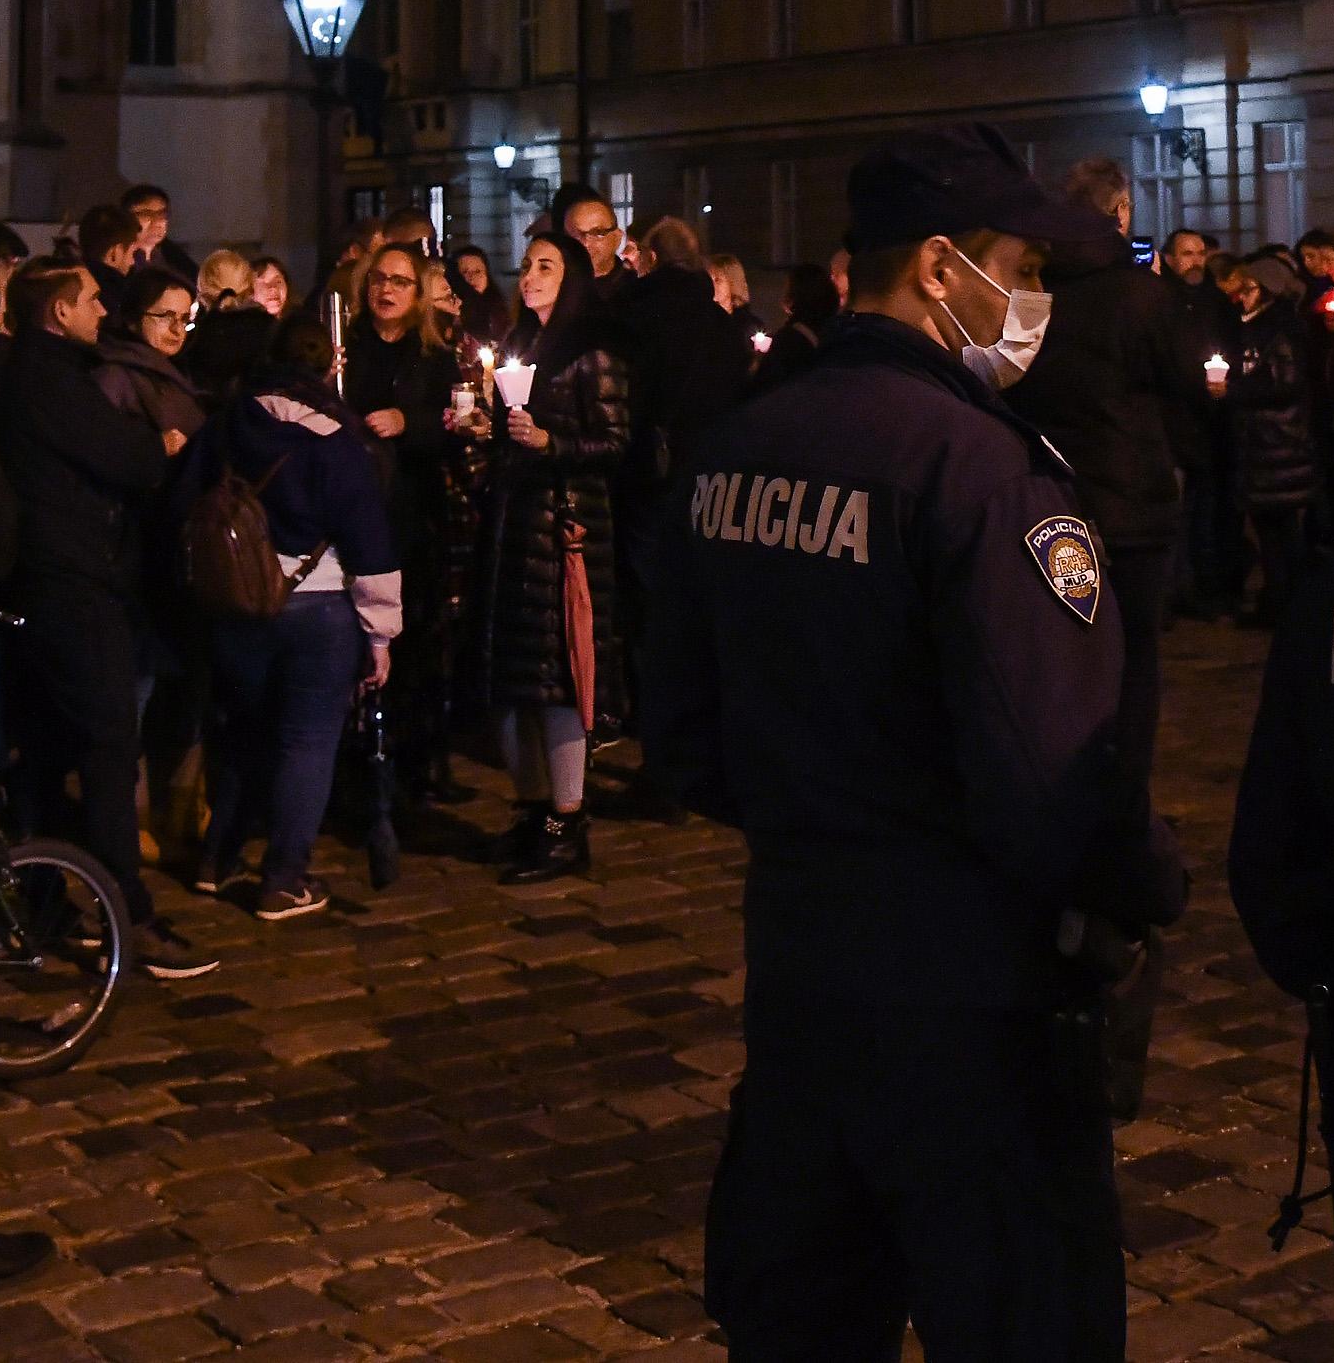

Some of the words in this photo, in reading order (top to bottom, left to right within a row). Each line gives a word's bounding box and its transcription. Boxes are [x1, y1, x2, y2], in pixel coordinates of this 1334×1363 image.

[691, 472, 869, 564] POLICIJA
[1032, 522, 1087, 548] POLICIJA
[1063, 574, 1088, 586] MUP
